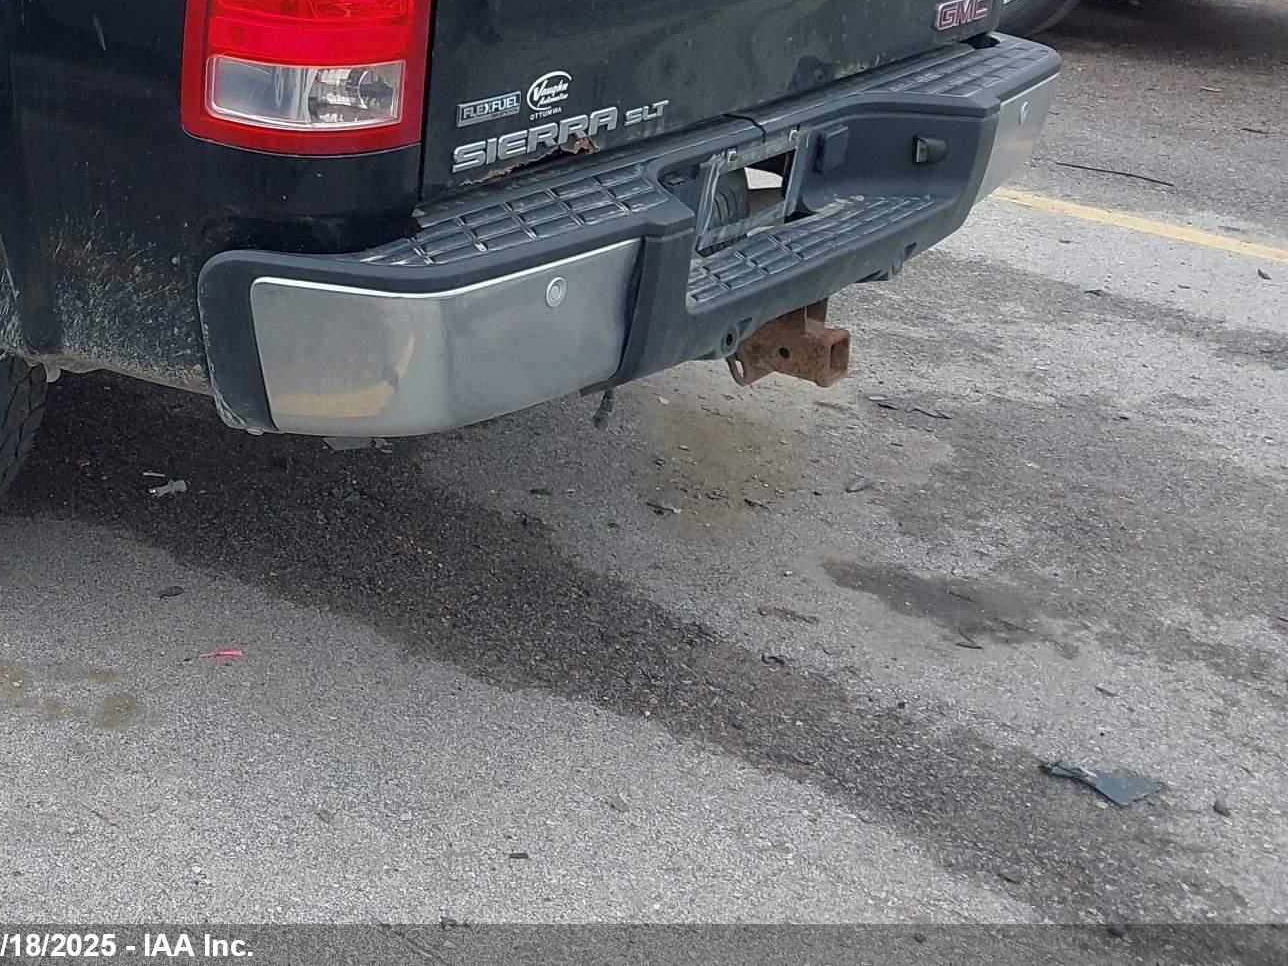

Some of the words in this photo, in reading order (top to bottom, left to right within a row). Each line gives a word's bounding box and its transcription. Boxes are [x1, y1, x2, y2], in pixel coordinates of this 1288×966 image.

[463, 95, 520, 119] FLEXFUEL
[529, 106, 563, 121] OTTUMWA
[451, 106, 619, 173] SIERRA
[623, 100, 670, 127] SLT
